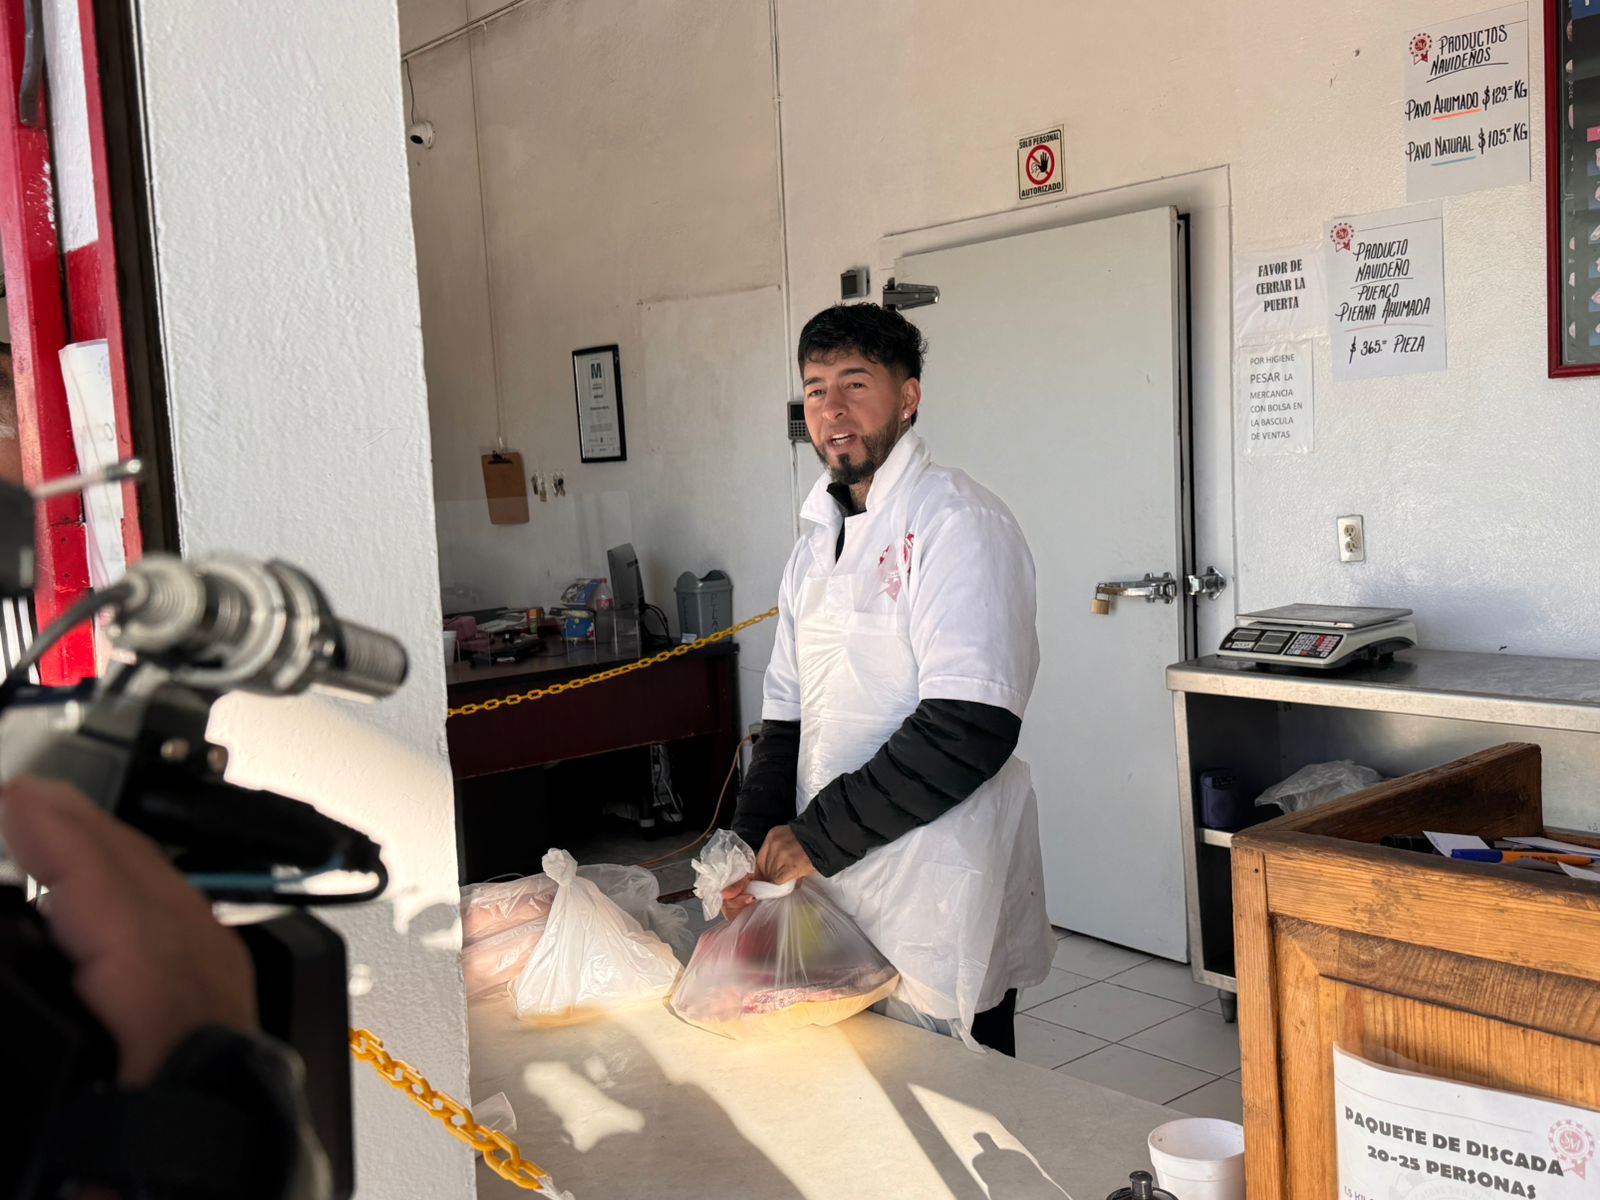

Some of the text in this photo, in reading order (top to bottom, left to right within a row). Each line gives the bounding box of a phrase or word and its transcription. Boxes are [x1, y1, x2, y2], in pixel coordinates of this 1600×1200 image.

[1437, 25, 1508, 55] PRODUCTOS
[1430, 48, 1491, 76] NAVIDEÑOS
[1405, 99, 1431, 121] PAVO
[1433, 91, 1479, 114] AHUMADO
[1514, 80, 1528, 99] KG
[1019, 132, 1060, 149] SOLO PERSONAL
[1405, 141, 1431, 162] PAVO
[1435, 135, 1474, 157] NATURAL
[1513, 123, 1528, 141] KG
[1021, 181, 1061, 197] AUTORIZADO
[1352, 239, 1408, 262] PRODUCTO
[1258, 259, 1303, 277] FAVOR DE
[1355, 258, 1410, 282] NAVIDEÑO
[1256, 277, 1306, 295] CERRAR LA
[1358, 283, 1399, 301] PUERCO
[1263, 296, 1299, 312] PUERTA
[1335, 297, 1430, 324] PIERNA AHUMADA
[1393, 334, 1425, 353] PIEZA
[1250, 354, 1295, 365] POR HIGIENE
[1250, 372, 1293, 384] PESAR LA
[1250, 389, 1293, 399] MERCANCIA
[1250, 402, 1303, 413] CON BOLSA EN
[1251, 416, 1294, 427] LA BASCULA
[1251, 430, 1290, 440] DE VENTAS
[1344, 1105, 1564, 1177] PAQUETE DE DISCADA
[1367, 1145, 1421, 1171] 20-25
[1426, 1159, 1536, 1200] PERSONAS
